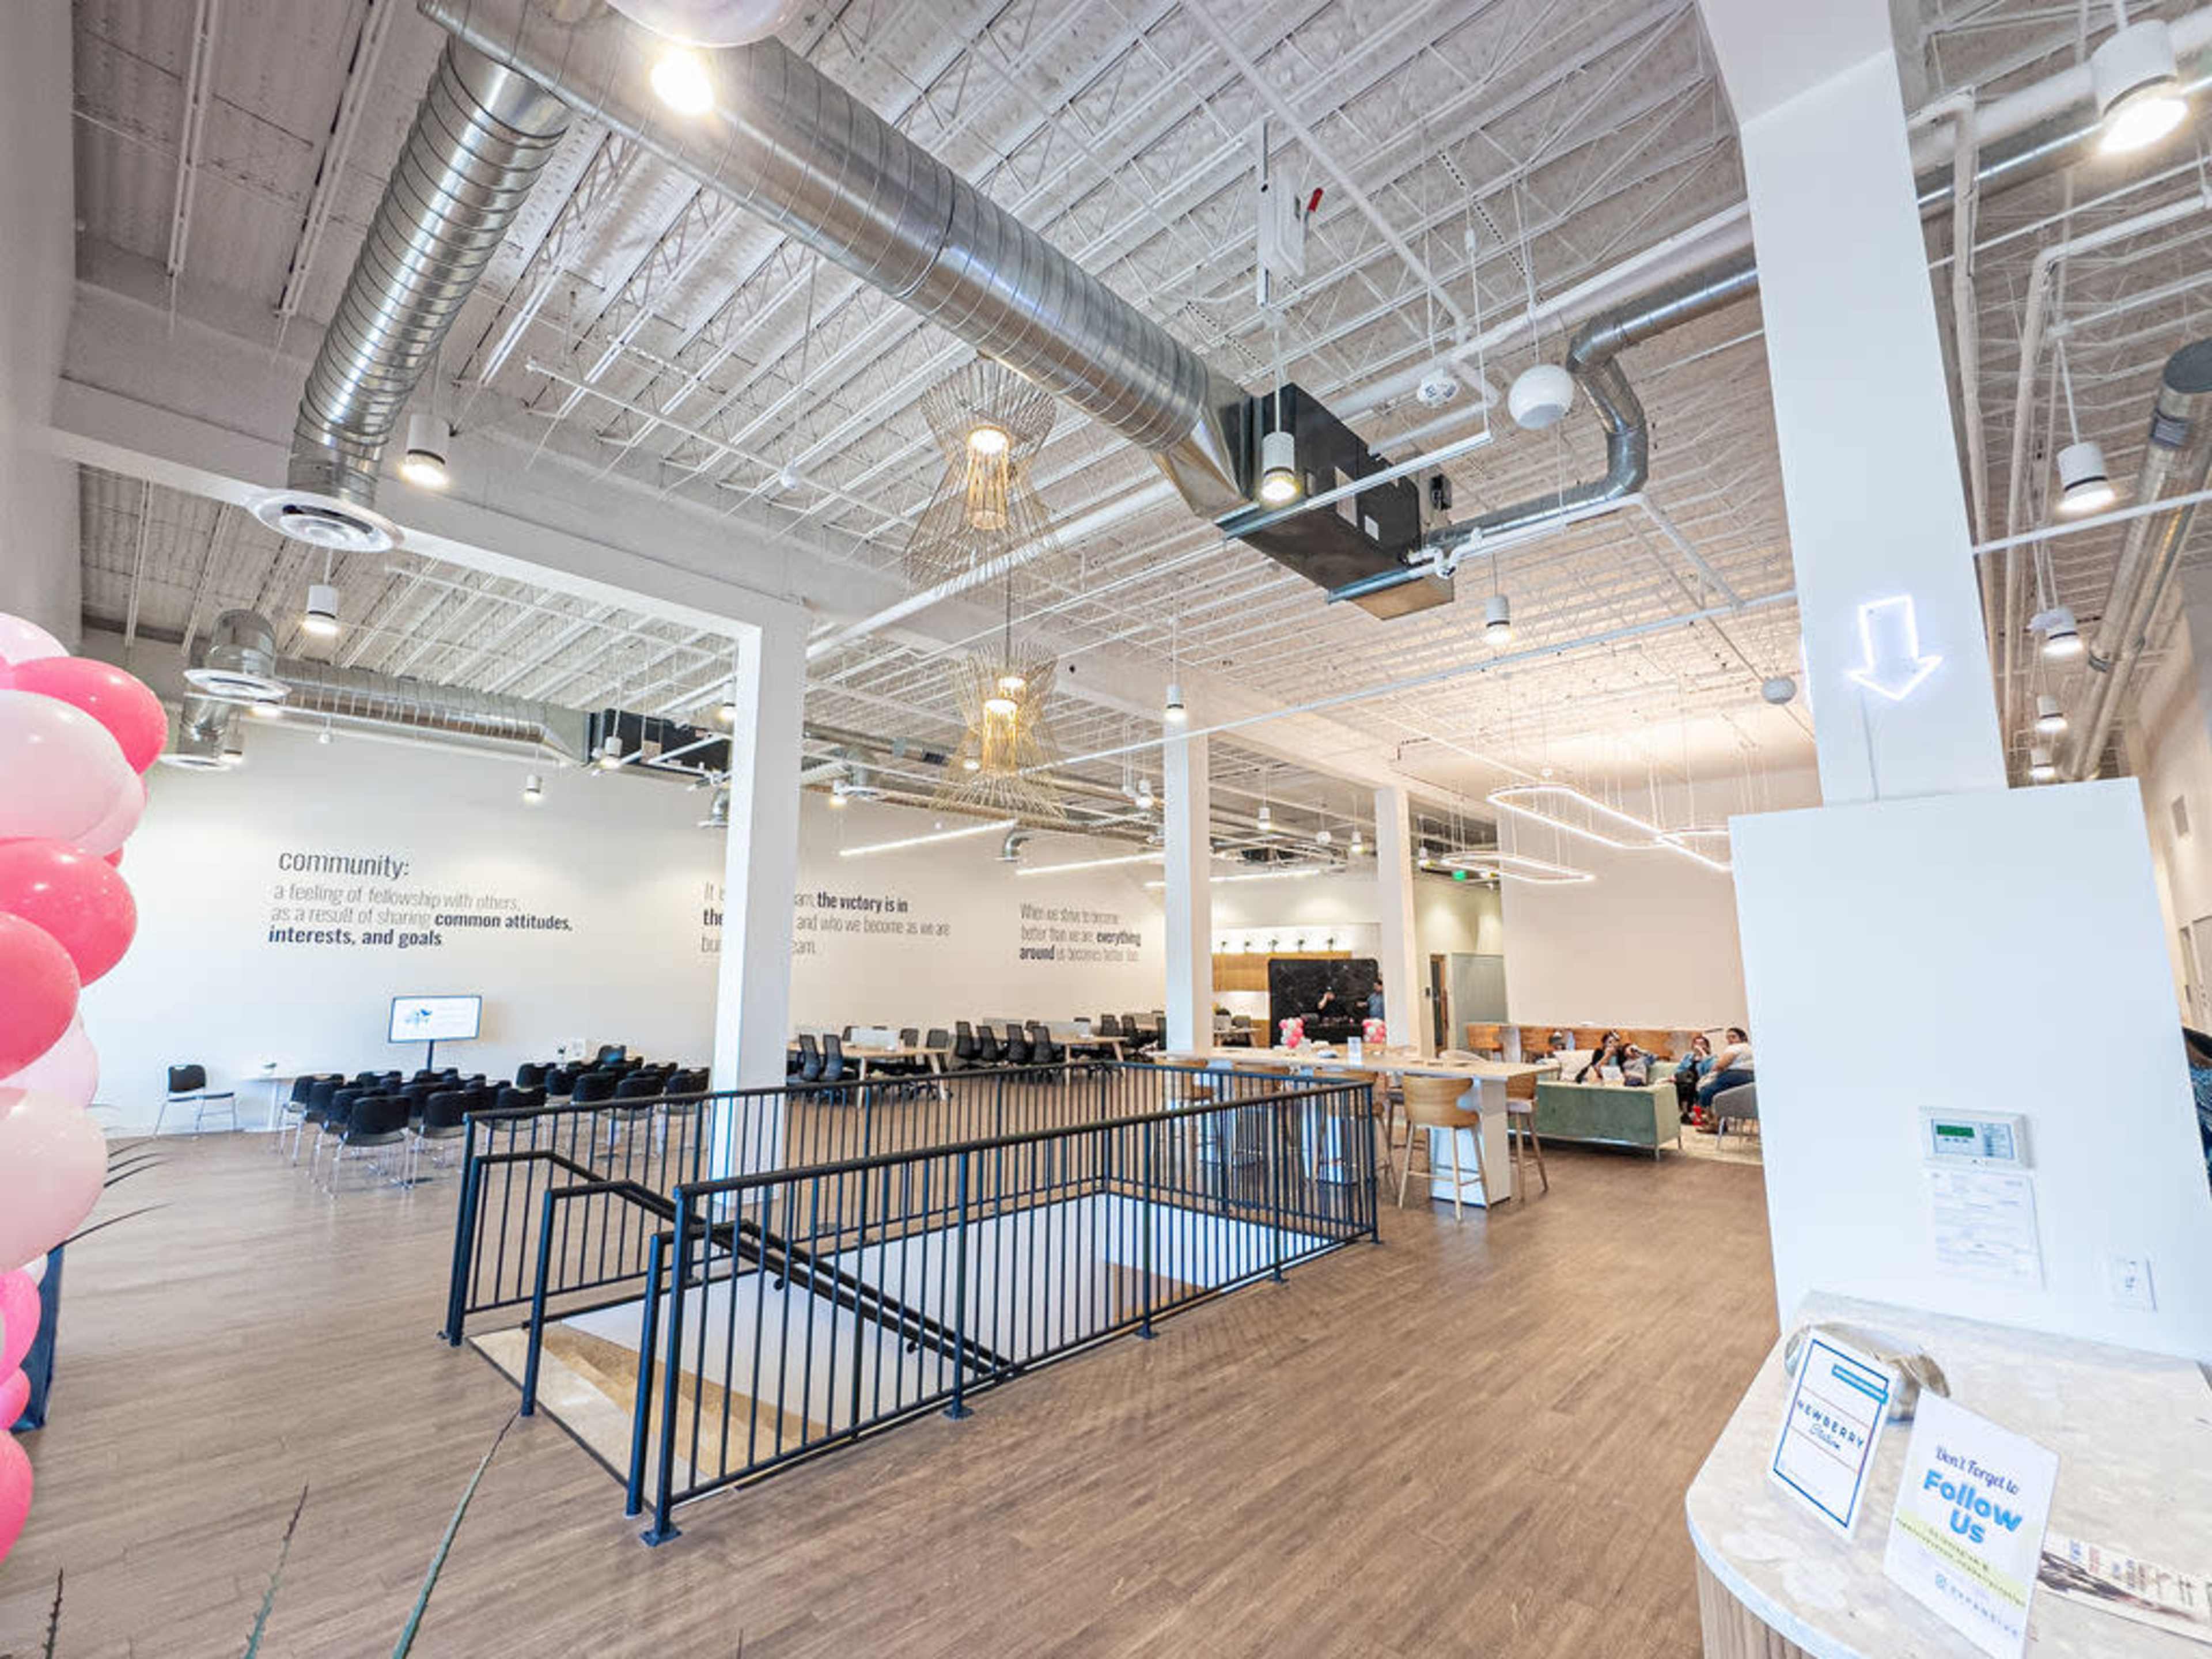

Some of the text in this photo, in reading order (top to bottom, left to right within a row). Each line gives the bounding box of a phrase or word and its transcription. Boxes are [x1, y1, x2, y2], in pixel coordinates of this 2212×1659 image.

[279, 853, 410, 881] community:
[274, 885, 284, 899] a
[289, 884, 344, 906] feeling
[347, 886, 362, 903] of
[369, 885, 441, 909] fellowship
[444, 893, 474, 908] with
[817, 891, 838, 908] the
[839, 894, 882, 914] victory
[885, 895, 895, 912] is
[897, 897, 908, 912] in
[271, 907, 290, 922] as
[294, 908, 305, 922] a
[309, 907, 353, 923] result
[358, 908, 373, 924] of
[377, 908, 430, 929] sharing
[435, 914, 501, 927] common
[797, 914, 817, 931] and
[820, 915, 842, 931] who
[844, 920, 862, 932] we
[864, 915, 903, 934] become
[907, 922, 918, 934] as
[362, 928, 394, 945] and
[397, 929, 442, 949] goals
[1097, 930, 1141, 947] everything
[1797, 1399, 1864, 1449] NEWBERRY
[1967, 1459, 2005, 1489] Forget
[1923, 1468, 2023, 1532] Follow
[1950, 1509, 1986, 1544] Us
